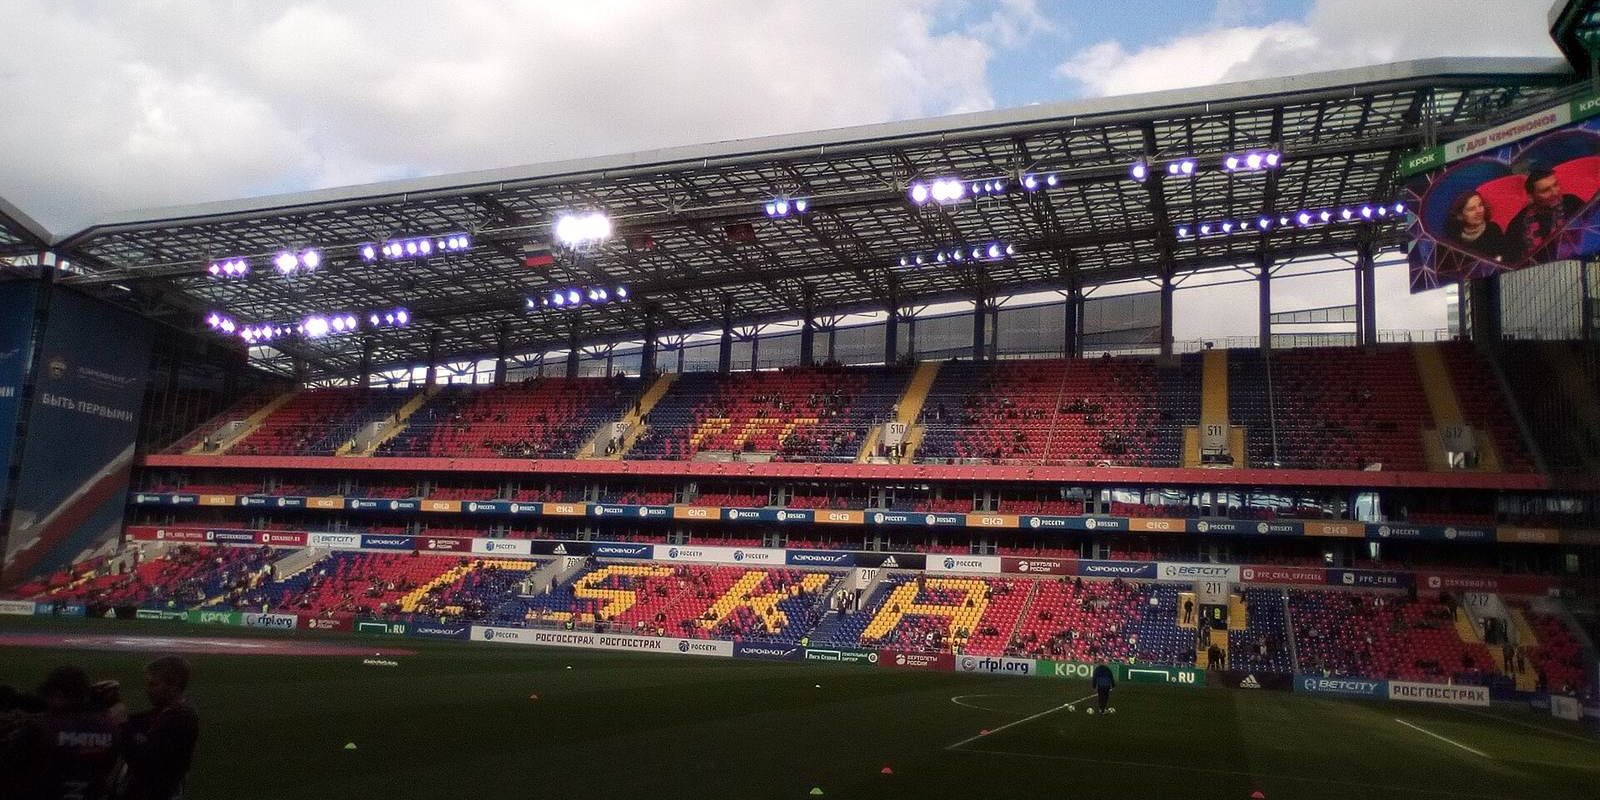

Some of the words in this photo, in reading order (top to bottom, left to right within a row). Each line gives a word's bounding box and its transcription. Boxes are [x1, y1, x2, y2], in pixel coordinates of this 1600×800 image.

[1409, 153, 1436, 169] КРОК
[42, 393, 76, 410] БЫТЬ
[78, 400, 133, 422] ПЕРВЫМИ
[891, 424, 904, 434] 510
[1207, 424, 1222, 437] 511
[792, 554, 835, 562] АЭРОФЛОТ
[1086, 565, 1134, 574] АЭРОФЛОТ
[1178, 566, 1231, 575] BETCITY
[1205, 582, 1221, 594] 211
[258, 615, 293, 628] rfpl.org
[495, 631, 519, 639] РОССЕТИ
[535, 633, 595, 645] РОСГОССТРАХ
[600, 637, 661, 649] РОСГОССТРАХ
[691, 643, 717, 652] РОССЕТИ
[740, 647, 785, 656] АЭРОФЛОТ
[978, 658, 1029, 674] rfpl.org
[1318, 679, 1379, 691] BETCITY
[1393, 685, 1485, 702] РОСГОССТРАХ
